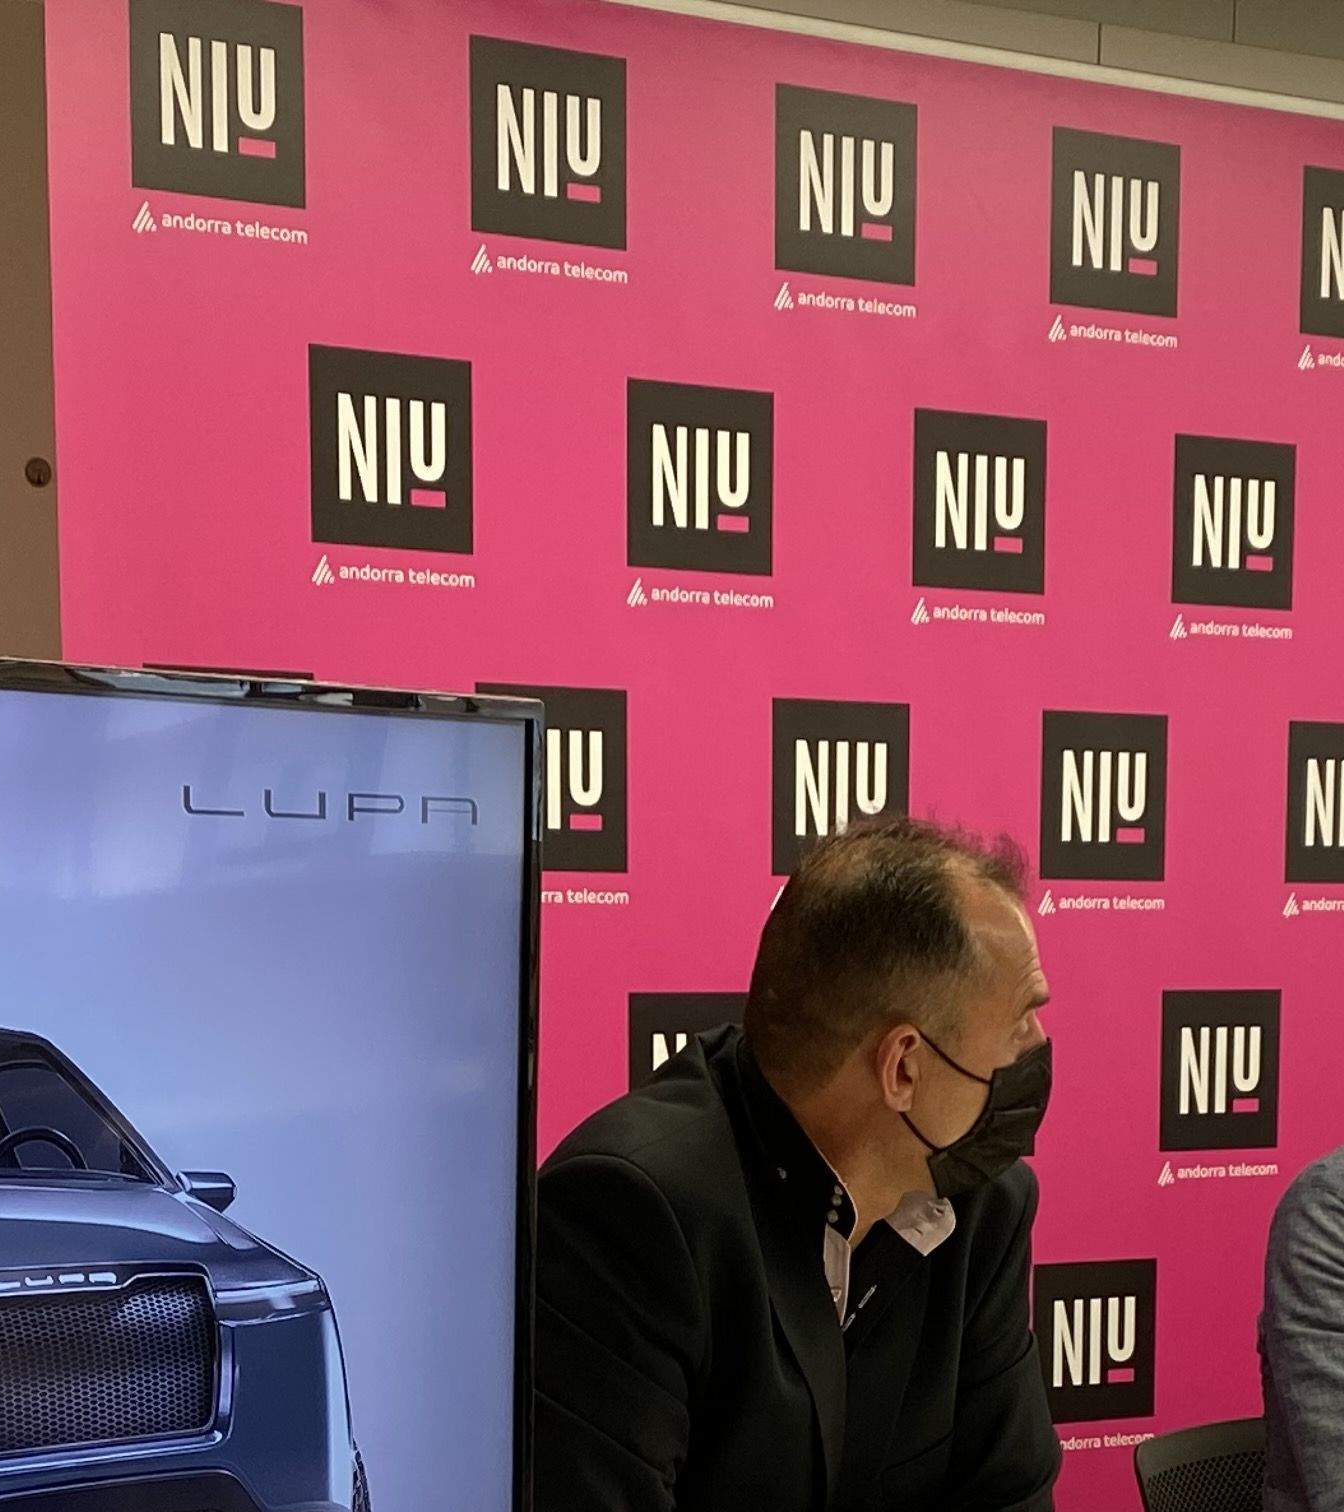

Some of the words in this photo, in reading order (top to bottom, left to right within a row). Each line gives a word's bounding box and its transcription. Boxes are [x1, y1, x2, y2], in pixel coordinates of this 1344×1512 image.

[160, 33, 275, 152] NIU
[498, 84, 600, 198] NIU
[800, 130, 893, 236] NIU
[161, 212, 233, 235] andorra
[234, 220, 308, 245] telecom
[1072, 171, 1158, 271] NIU
[496, 254, 561, 276] andorra
[563, 261, 629, 285] telecom
[797, 291, 855, 312] andorra
[857, 297, 917, 319] telecom
[1068, 323, 1123, 342] andorra
[1123, 328, 1178, 349] telecom
[338, 393, 445, 504] NIU
[653, 424, 749, 529] NIU
[936, 451, 1024, 551] NIU
[1193, 475, 1275, 569] NIU
[338, 563, 405, 584] andorra
[408, 568, 476, 589] telecom
[650, 585, 711, 605] andorra
[713, 589, 774, 609] telecom
[932, 604, 988, 623] andorra
[989, 607, 1046, 626] telecom
[1188, 620, 1240, 637] andorra
[1241, 623, 1293, 640] telecom
[547, 729, 602, 829] IU
[796, 740, 886, 836] NIU
[1062, 750, 1146, 842] NIU
[566, 887, 630, 905] telecom
[1058, 895, 1111, 910] andorra
[1112, 895, 1166, 911] telecom
[1180, 1027, 1260, 1114] NIU
[1176, 1164, 1227, 1180] andorra
[1227, 1162, 1279, 1177] telecom
[1053, 1296, 1135, 1387] NIU
[1059, 1436, 1102, 1451] ndorra
